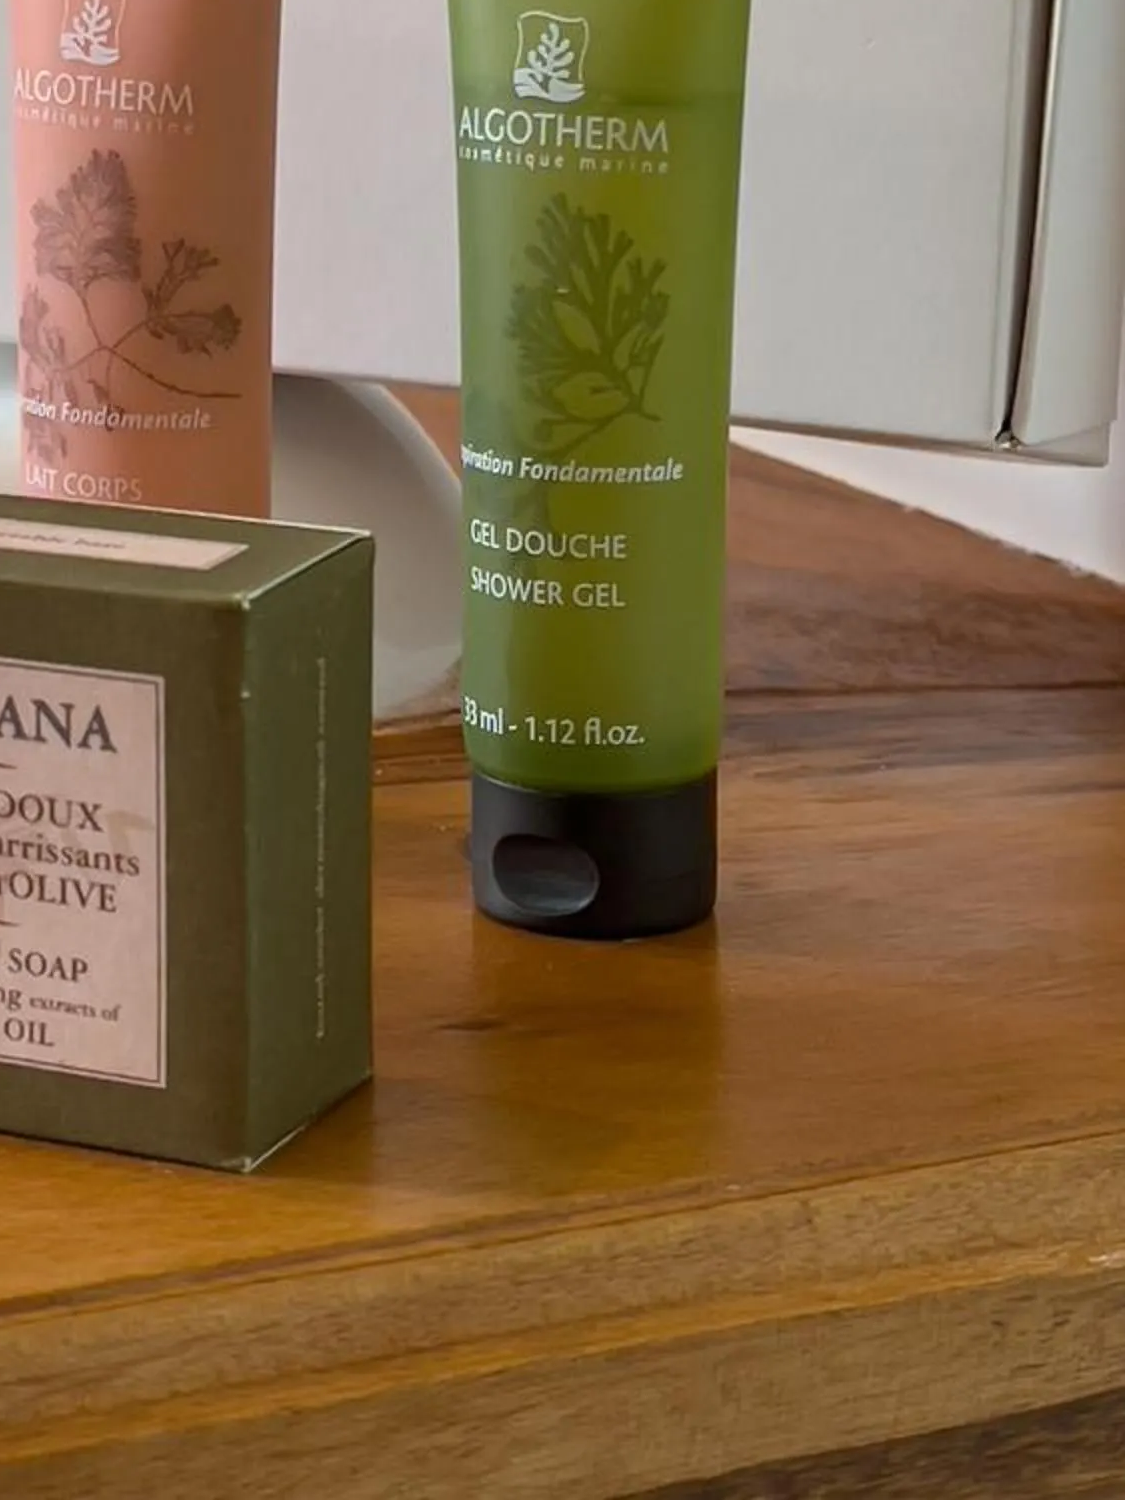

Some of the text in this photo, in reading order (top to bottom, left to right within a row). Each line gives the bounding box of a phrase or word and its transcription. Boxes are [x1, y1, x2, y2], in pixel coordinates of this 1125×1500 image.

[14, 67, 194, 116] ALGOTHERM
[459, 105, 669, 153] ALGOTHERM
[579, 156, 669, 174] marine
[61, 402, 213, 431] Fondamentale
[63, 472, 143, 501] CORPS
[519, 457, 684, 484] Fondamentale
[470, 518, 627, 559] GEL DOUCHE
[470, 566, 626, 608] SHOWER GEL
[480, 707, 504, 735] ml
[525, 716, 576, 745] 1.12
[8, 947, 90, 984] SOAP
[29, 996, 97, 1019] extracts
[101, 1005, 122, 1023] of
[4, 1016, 55, 1047] OIL
